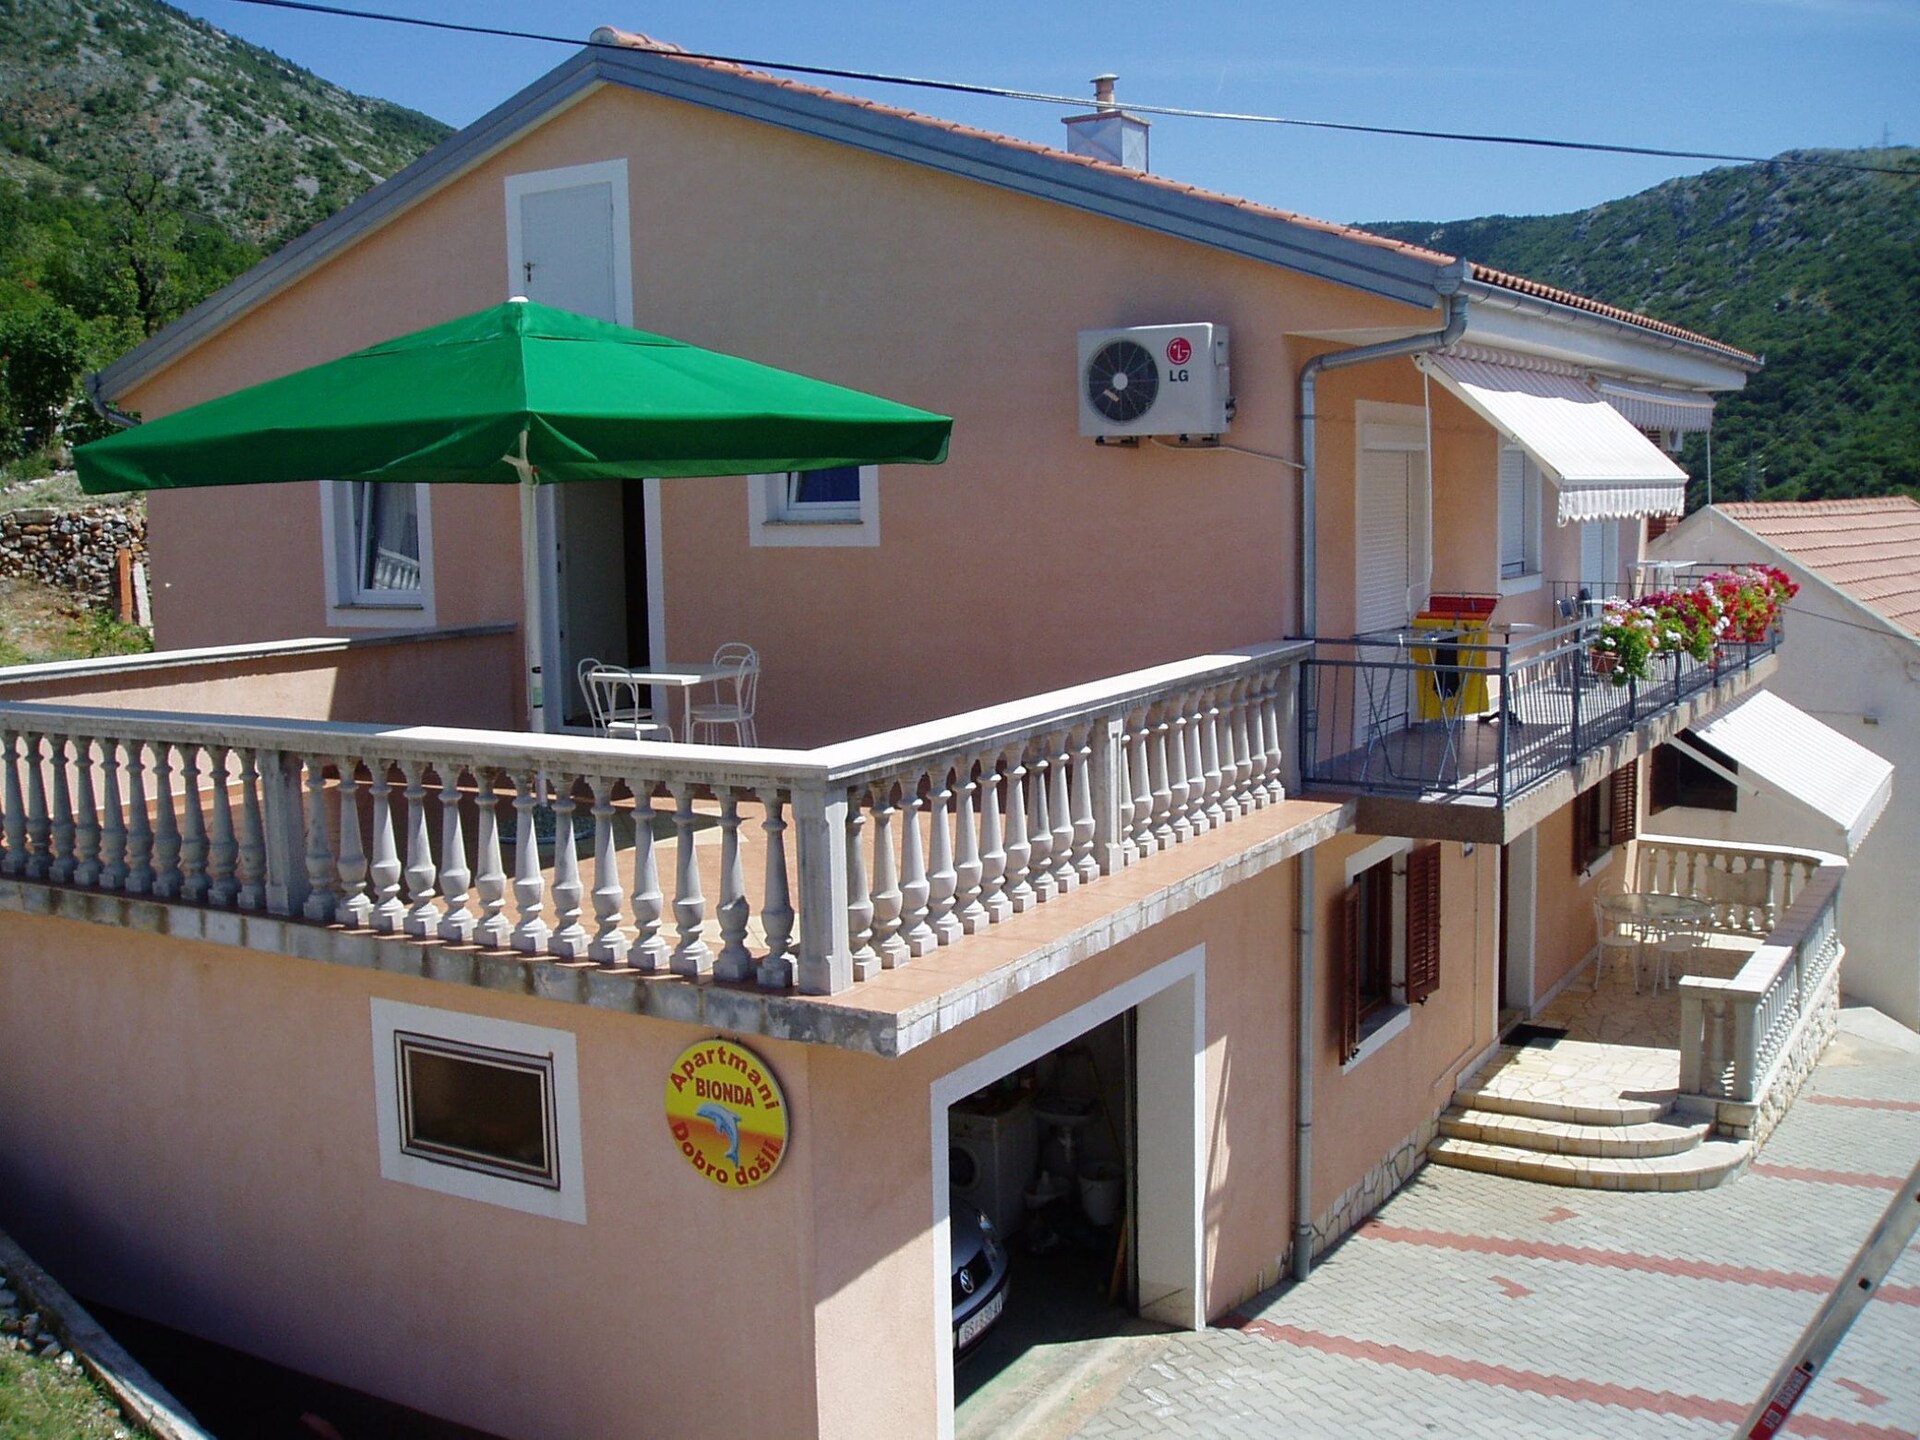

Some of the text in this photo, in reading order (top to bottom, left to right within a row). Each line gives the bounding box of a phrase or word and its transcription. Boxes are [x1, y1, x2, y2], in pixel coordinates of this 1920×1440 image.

[1169, 369, 1189, 382] LG
[670, 1046, 780, 1110] Apartmani
[695, 1077, 755, 1108] BIONDA
[672, 1121, 729, 1184] Dobro
